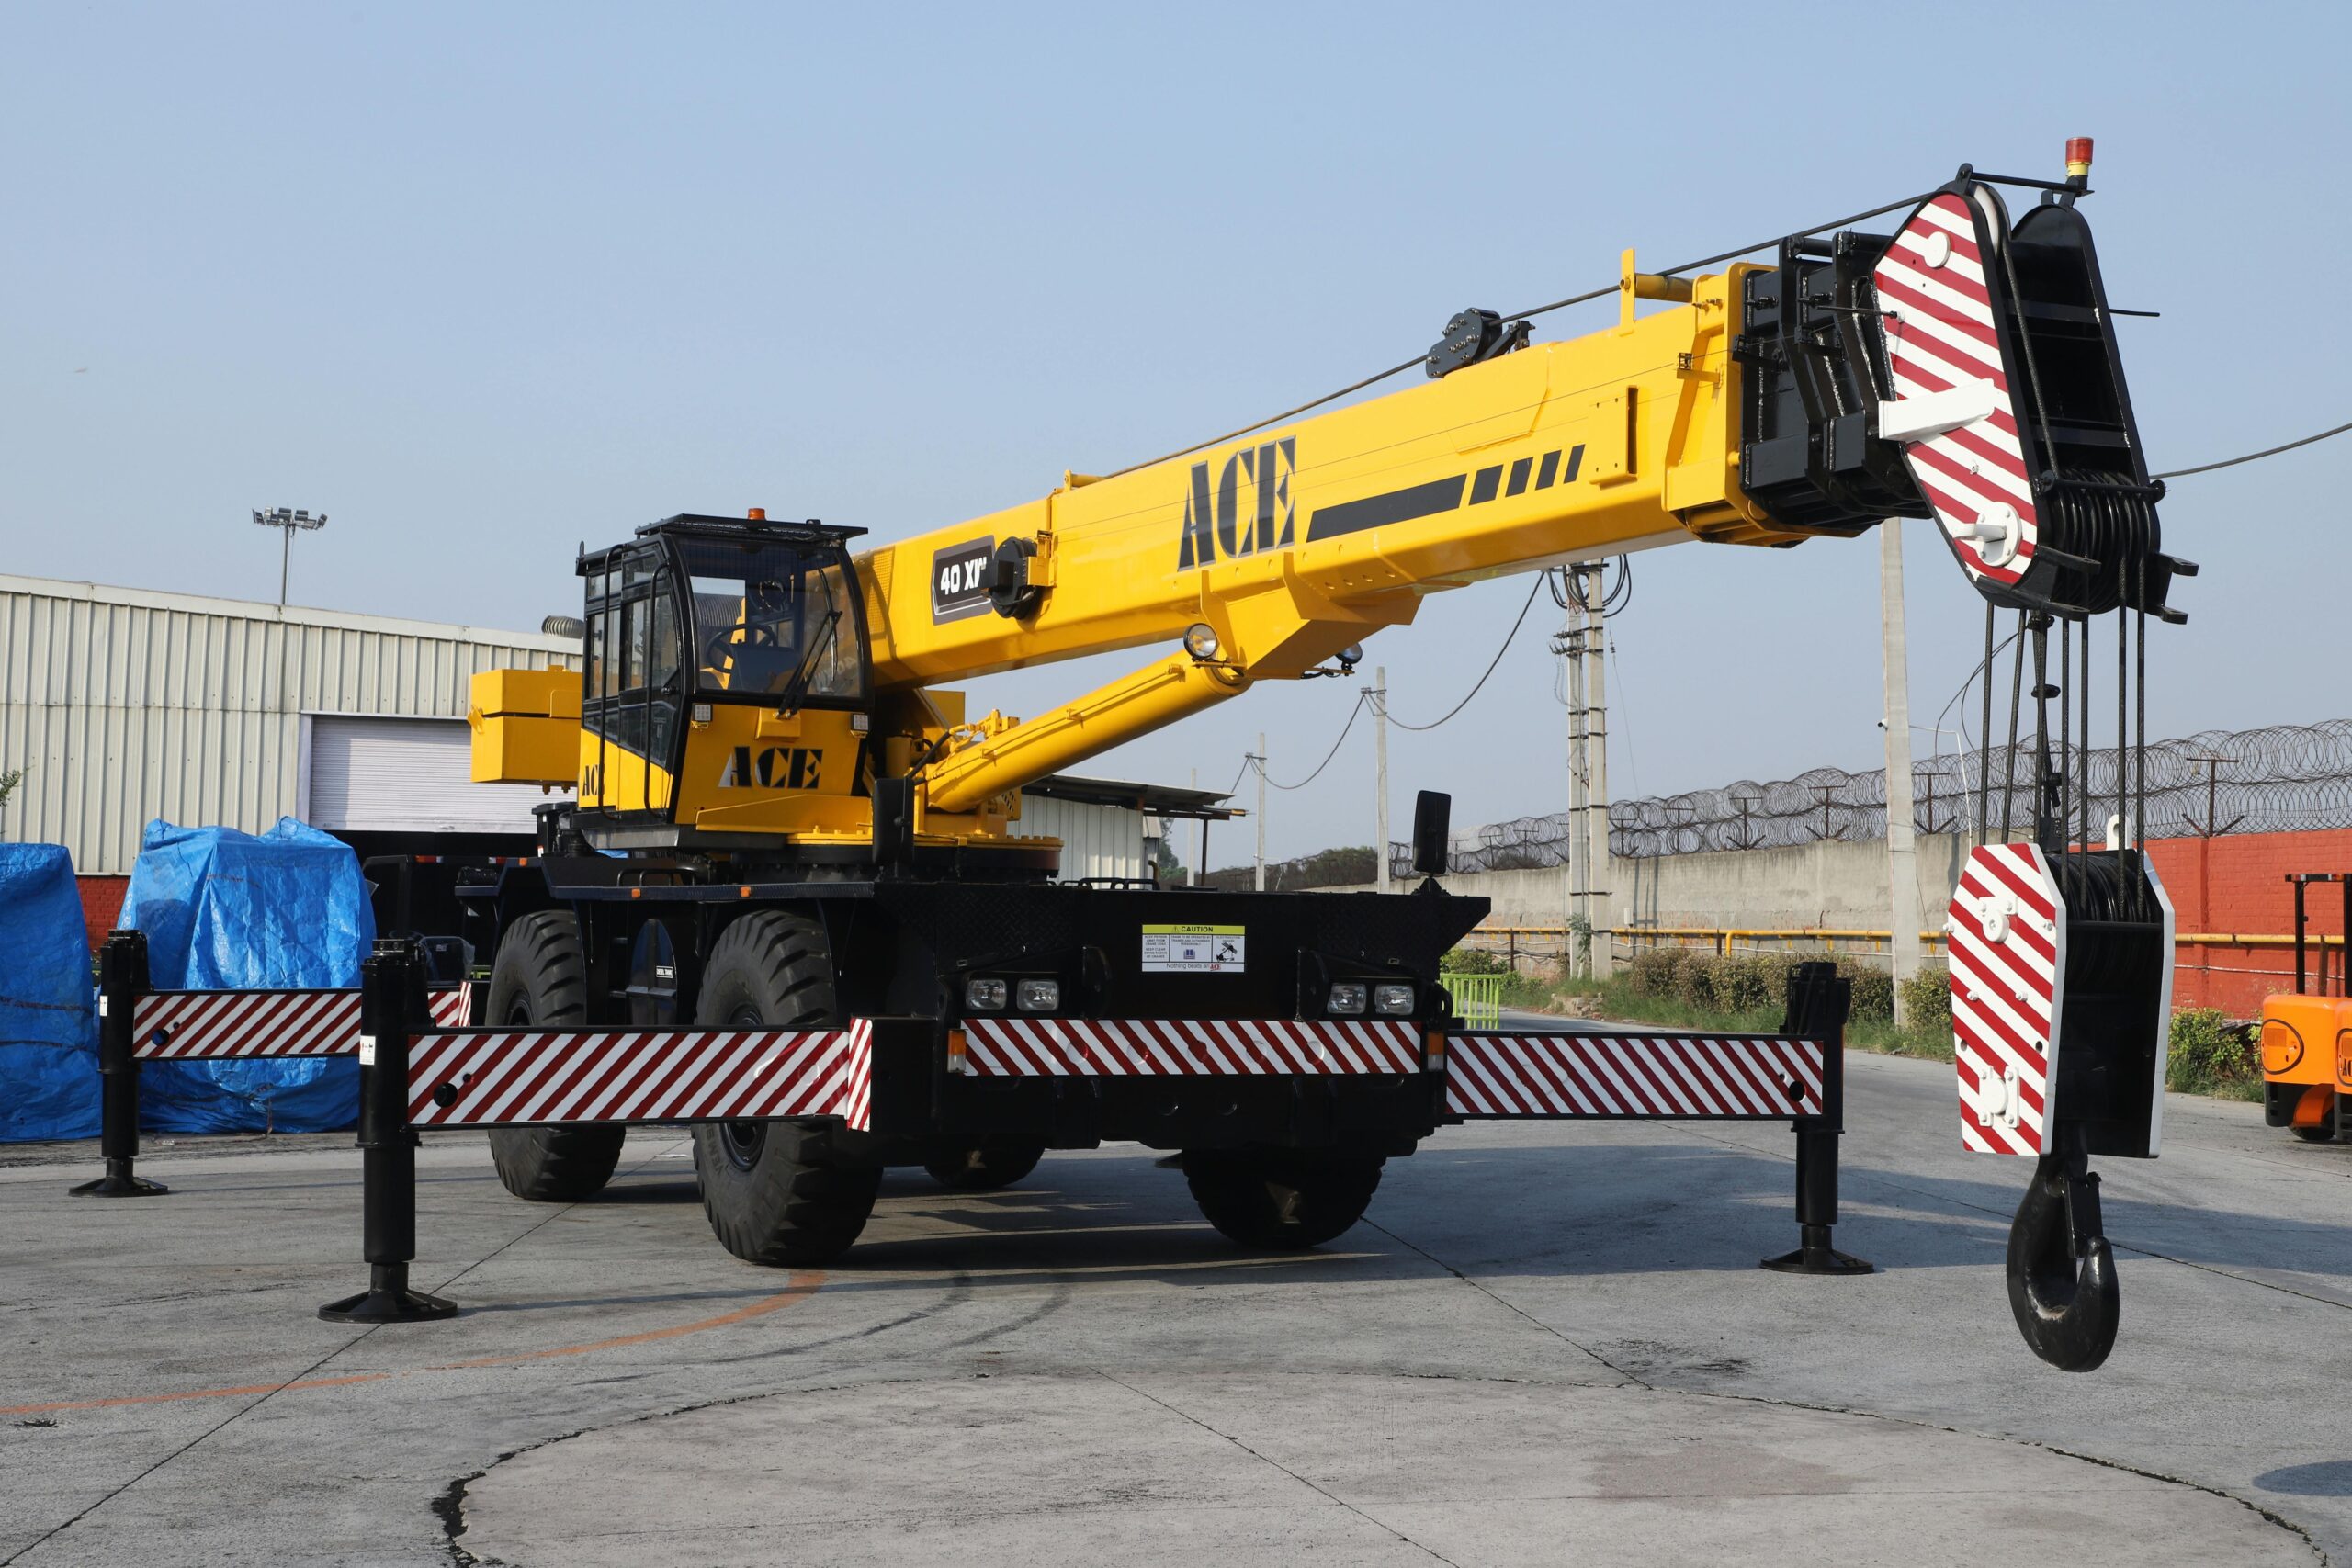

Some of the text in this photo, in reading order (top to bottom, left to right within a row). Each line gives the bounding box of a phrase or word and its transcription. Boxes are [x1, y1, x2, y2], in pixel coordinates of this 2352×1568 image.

[1177, 434, 1296, 572] ACE
[940, 564, 961, 595] 40
[717, 745, 824, 789] ACE
